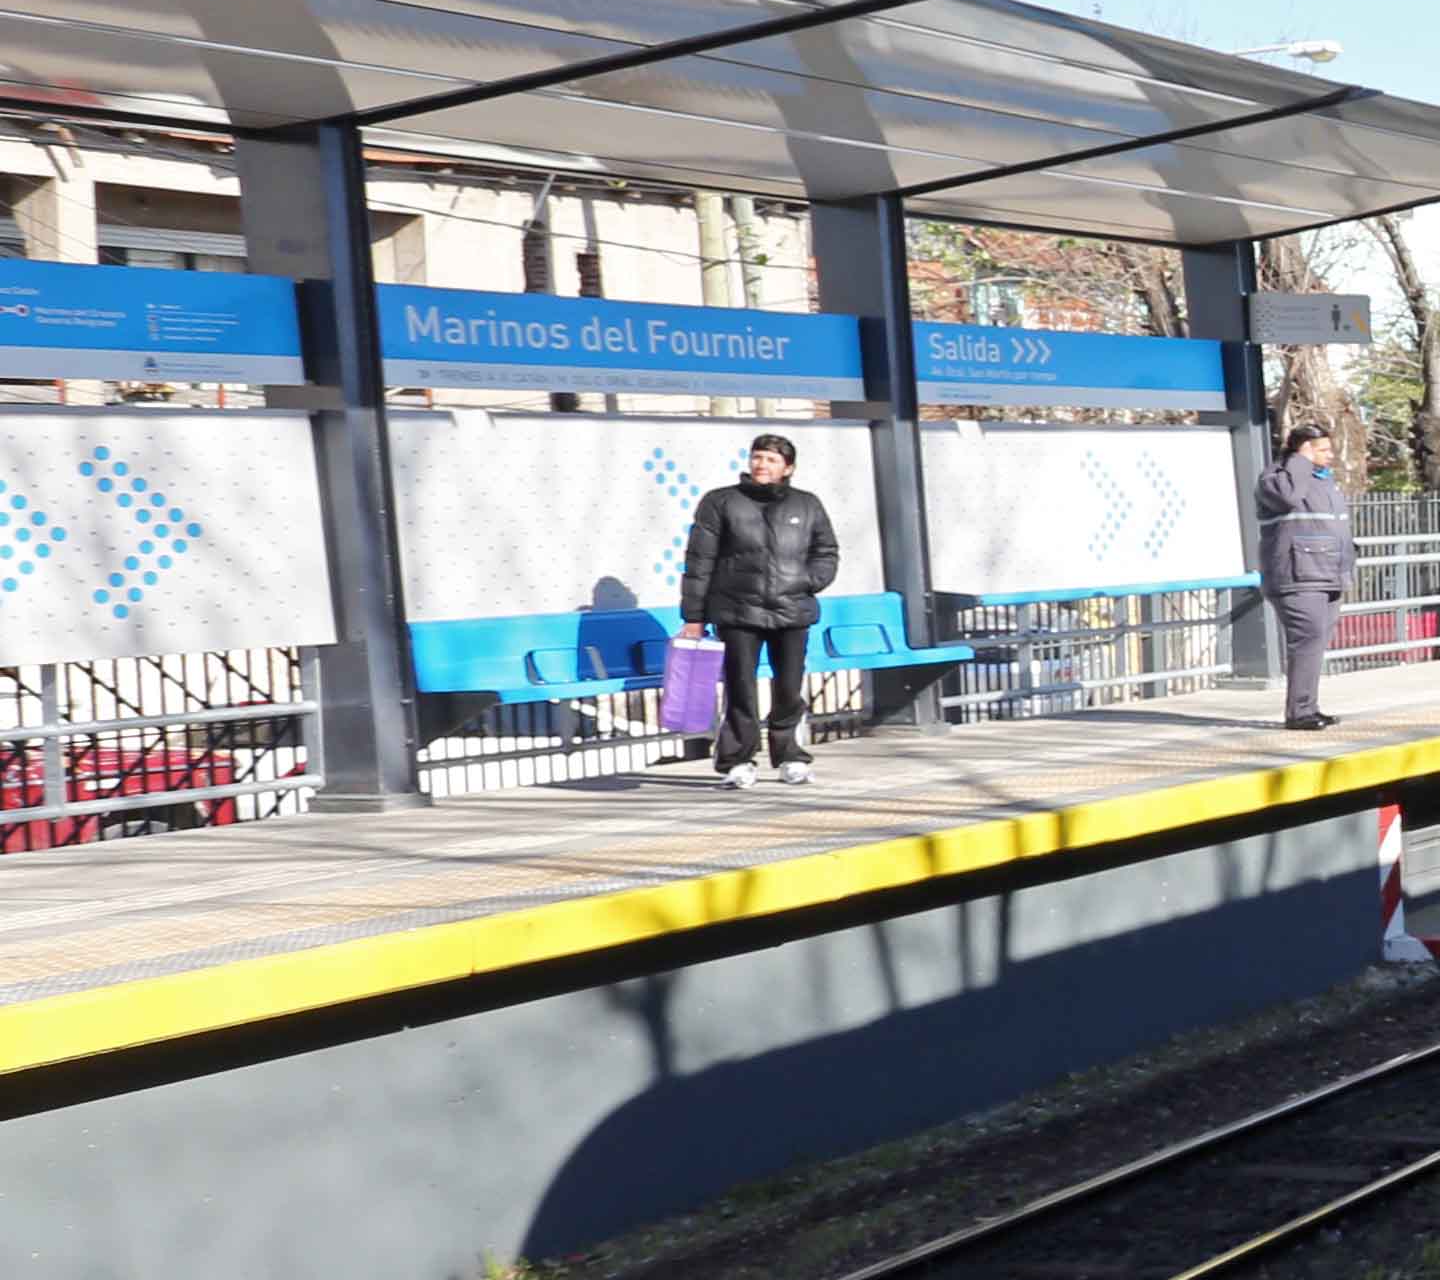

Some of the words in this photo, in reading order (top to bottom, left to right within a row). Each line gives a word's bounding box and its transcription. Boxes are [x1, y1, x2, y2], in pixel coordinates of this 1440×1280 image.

[404, 304, 571, 350] Marinos
[579, 315, 639, 353] del
[647, 319, 790, 361] Fournier
[928, 332, 1001, 363] Salida
